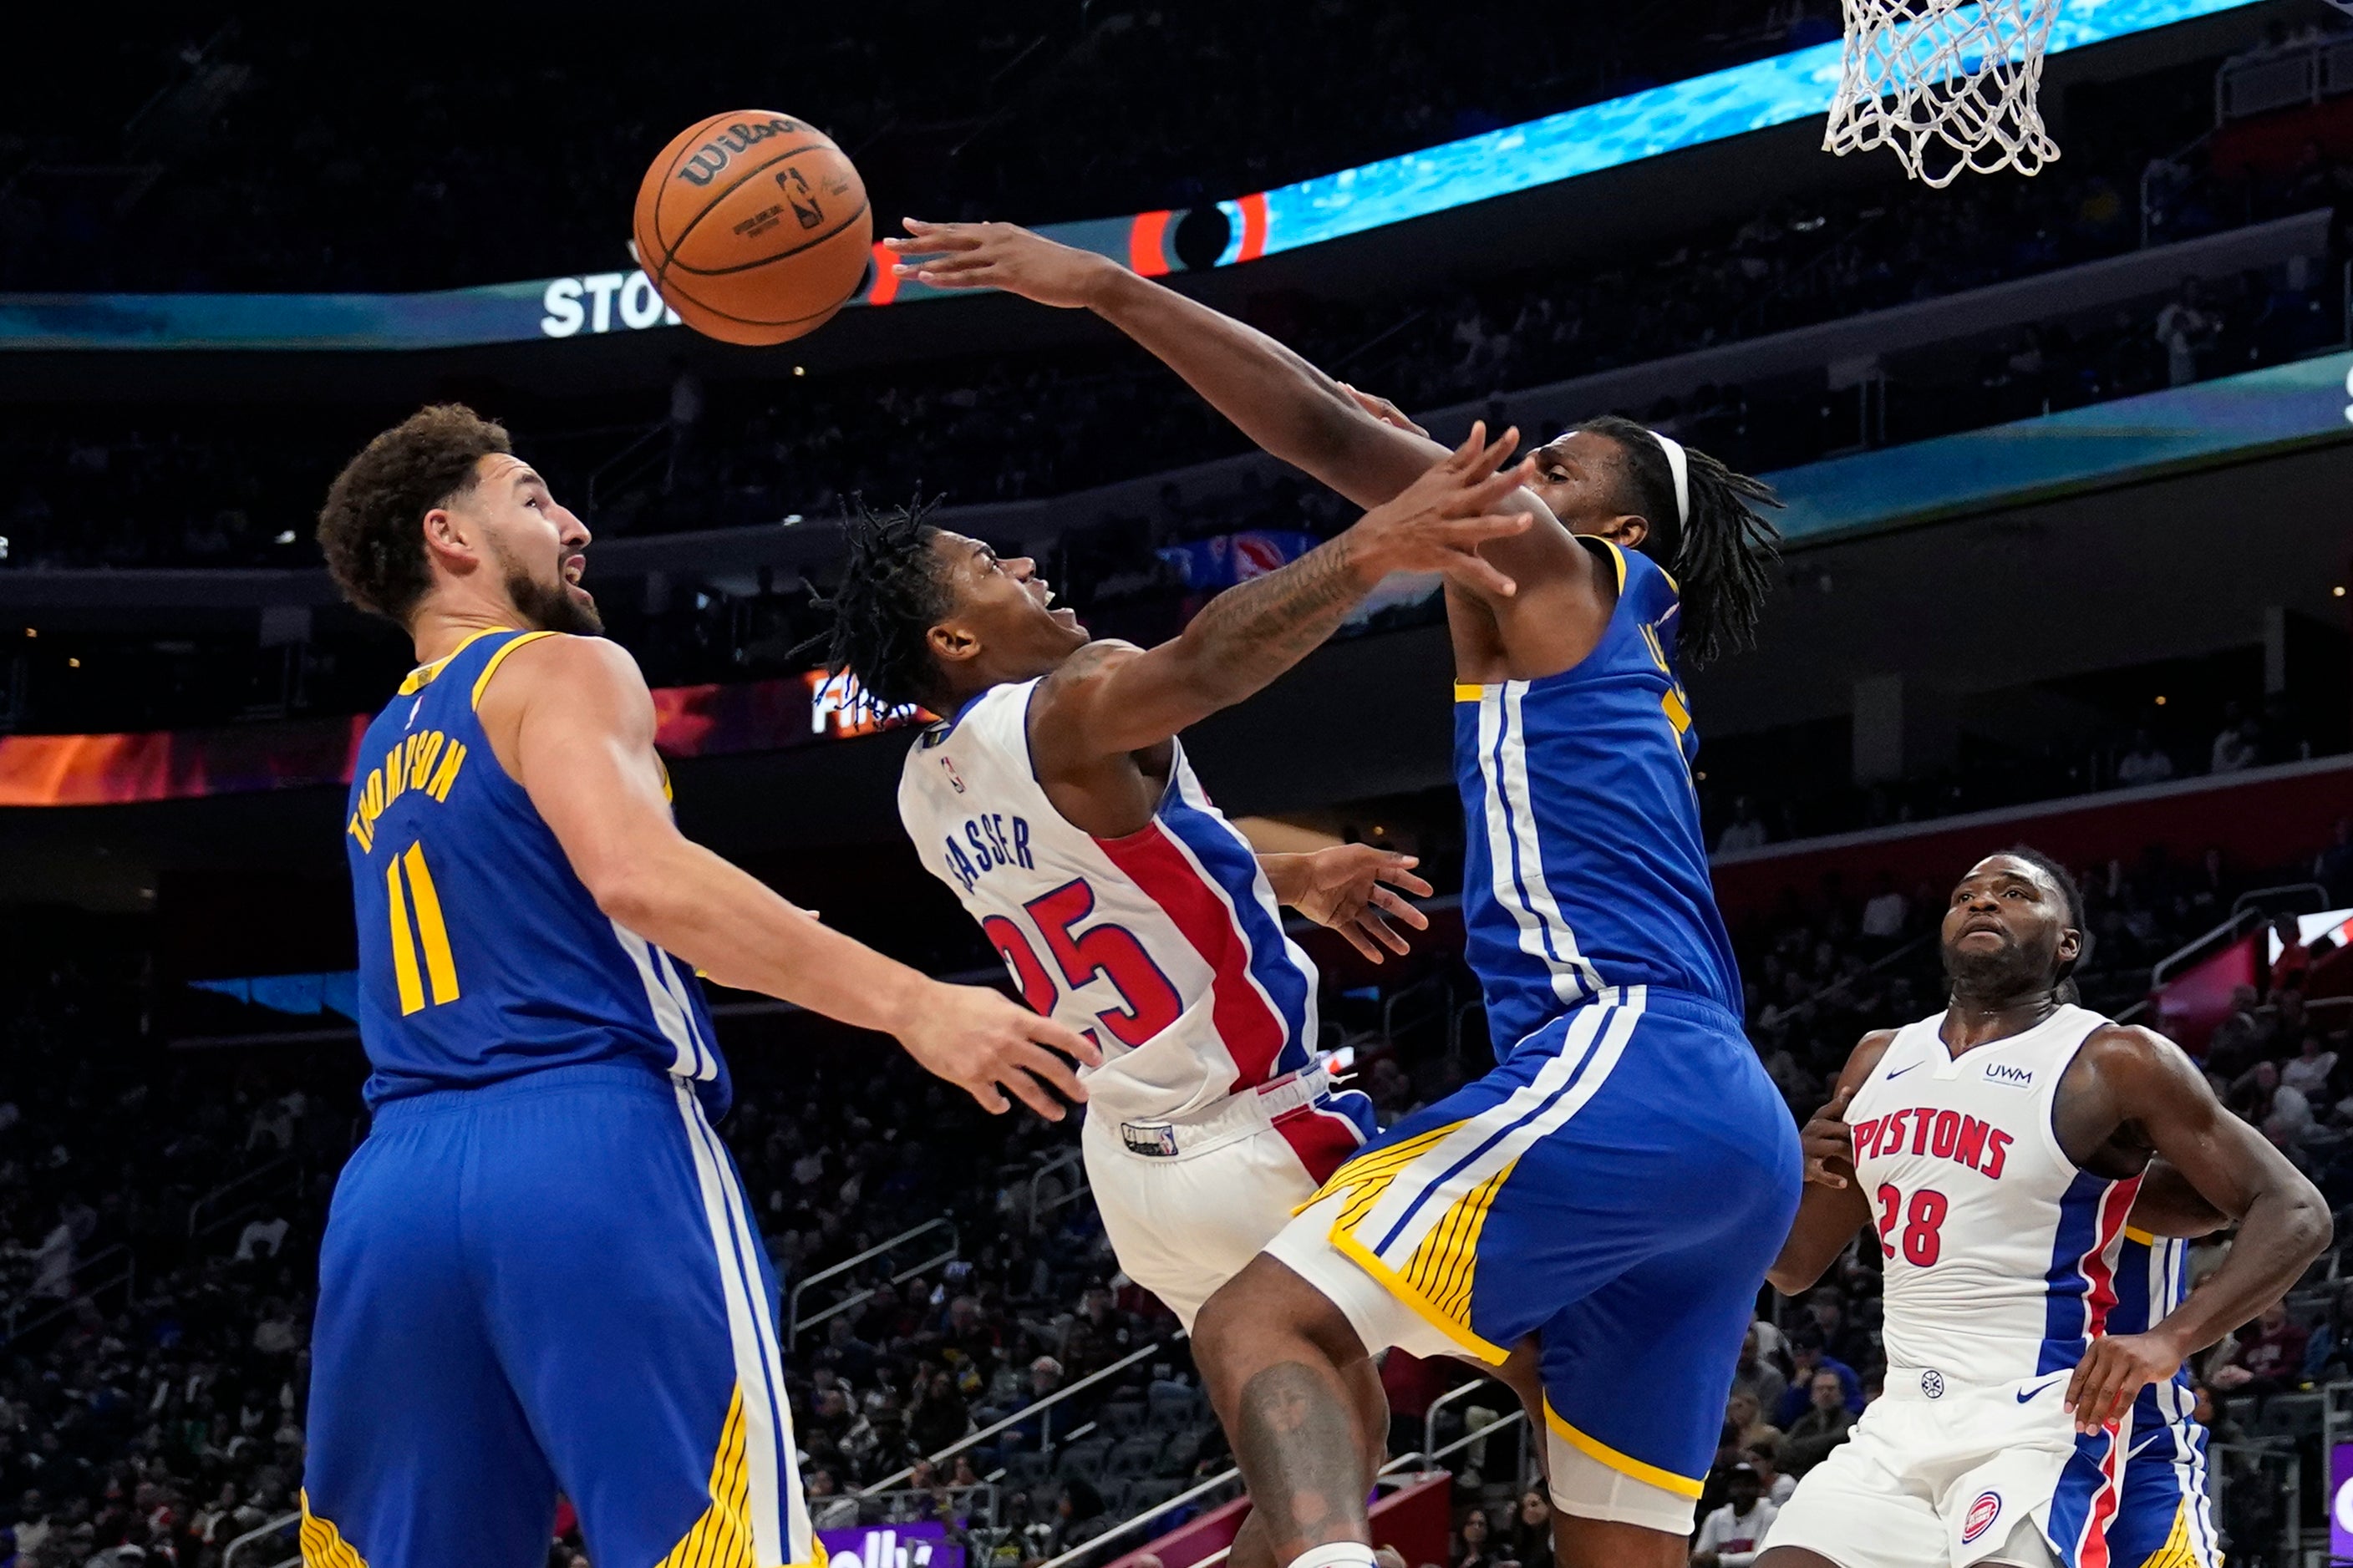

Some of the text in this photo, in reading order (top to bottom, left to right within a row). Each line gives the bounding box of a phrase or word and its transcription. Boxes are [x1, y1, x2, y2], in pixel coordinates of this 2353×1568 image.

[348, 729, 467, 855] THOMPSON
[386, 839, 460, 1017] 11
[1985, 1063, 2033, 1083] UWM
[1853, 1107, 2014, 1180] PISTONS
[1878, 1183, 1948, 1267] 28
